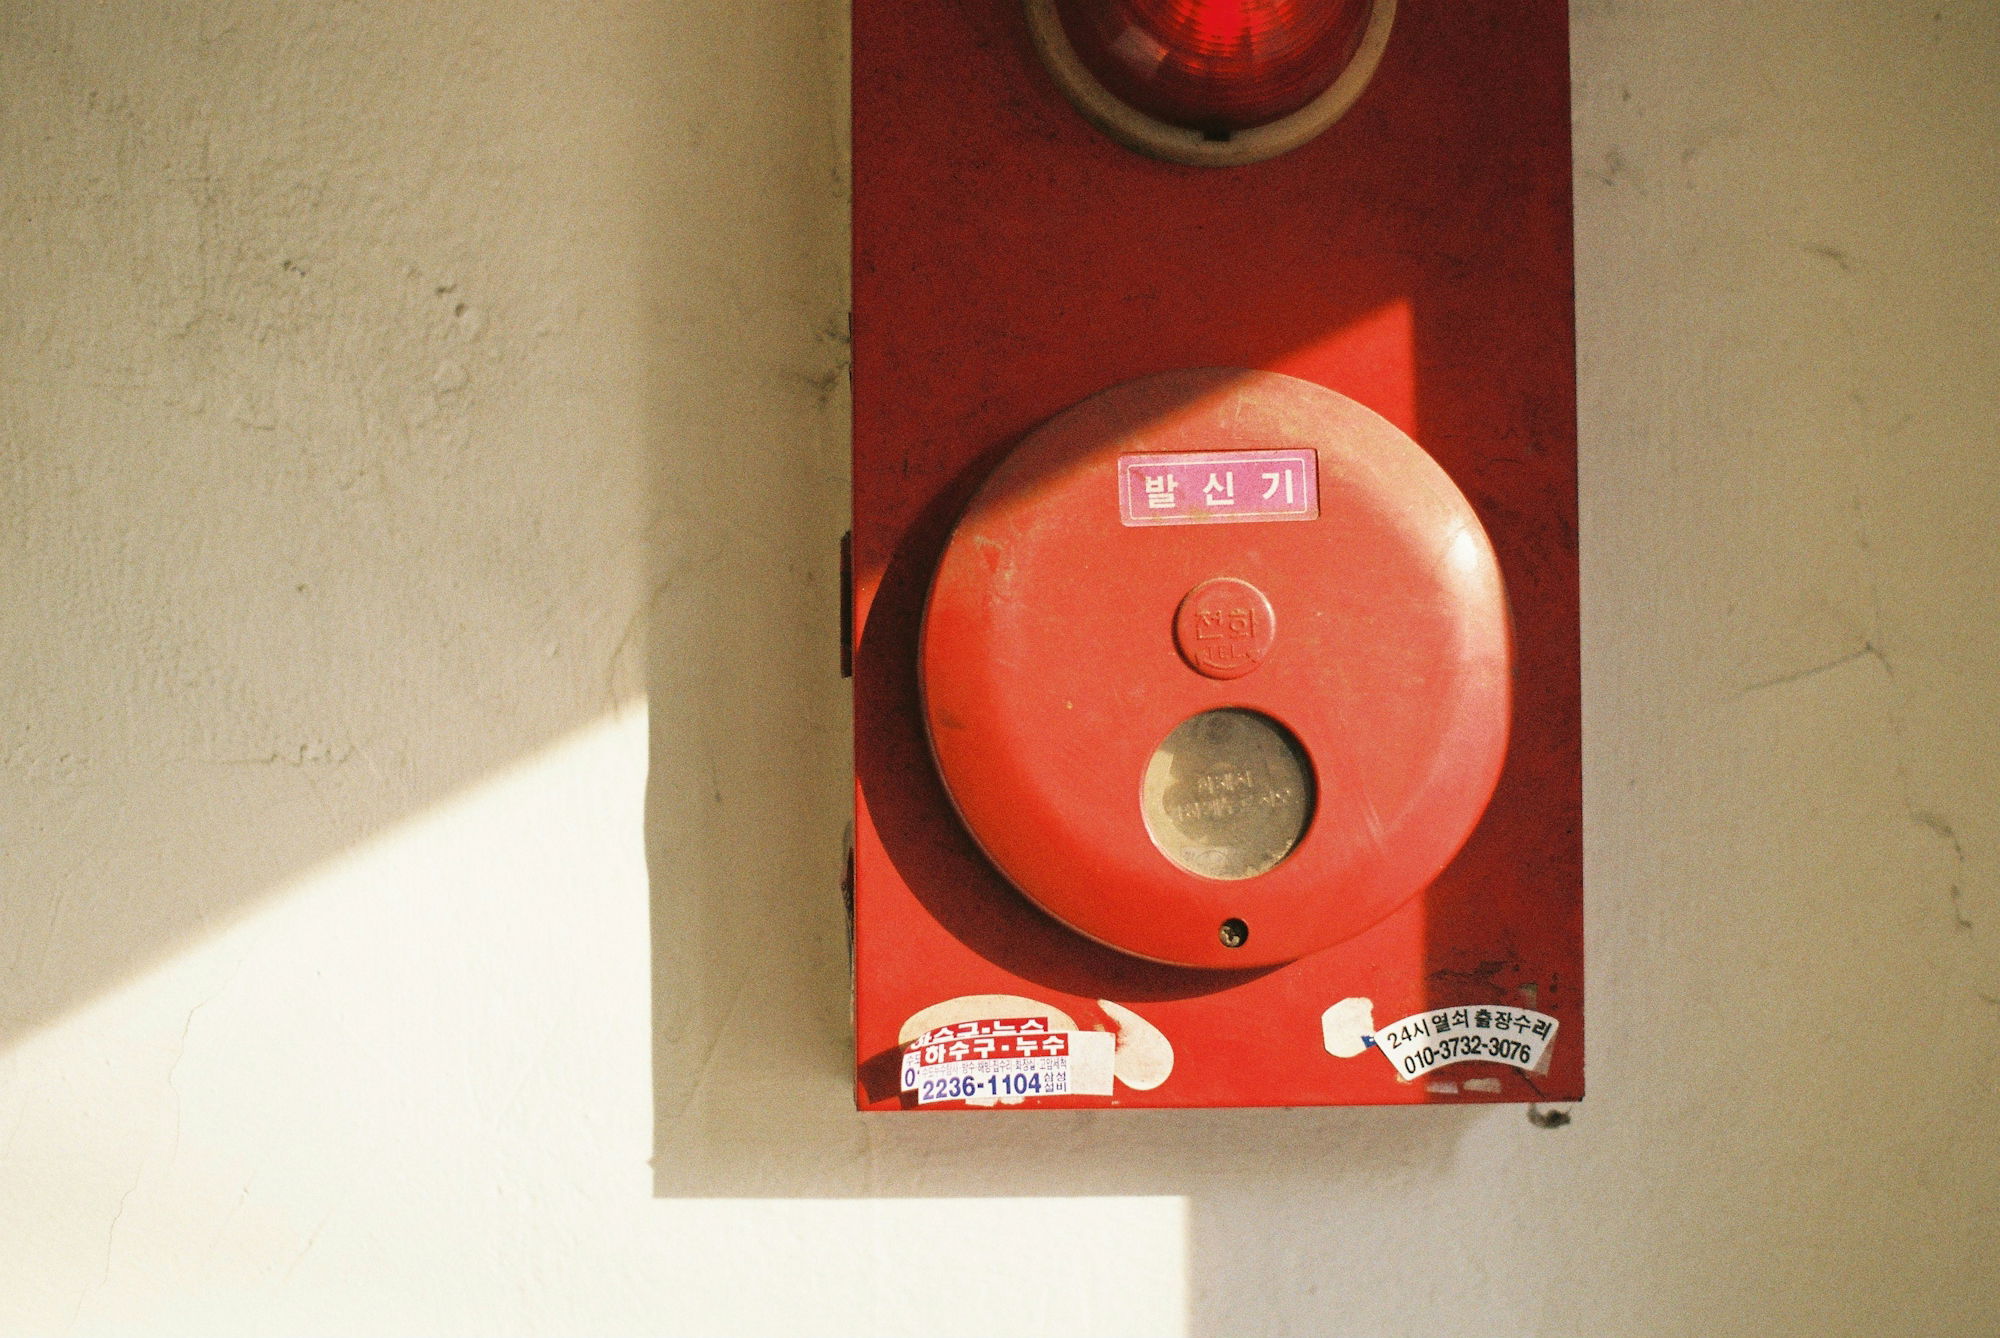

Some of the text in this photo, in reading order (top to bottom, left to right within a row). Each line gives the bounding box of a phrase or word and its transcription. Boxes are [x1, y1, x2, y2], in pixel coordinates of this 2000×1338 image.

[1387, 1008, 1553, 1050] 24시 열쇠 출장수리
[1404, 1035, 1531, 1074] 010-3732-3076
[922, 1072, 1042, 1101] 2236-1104
